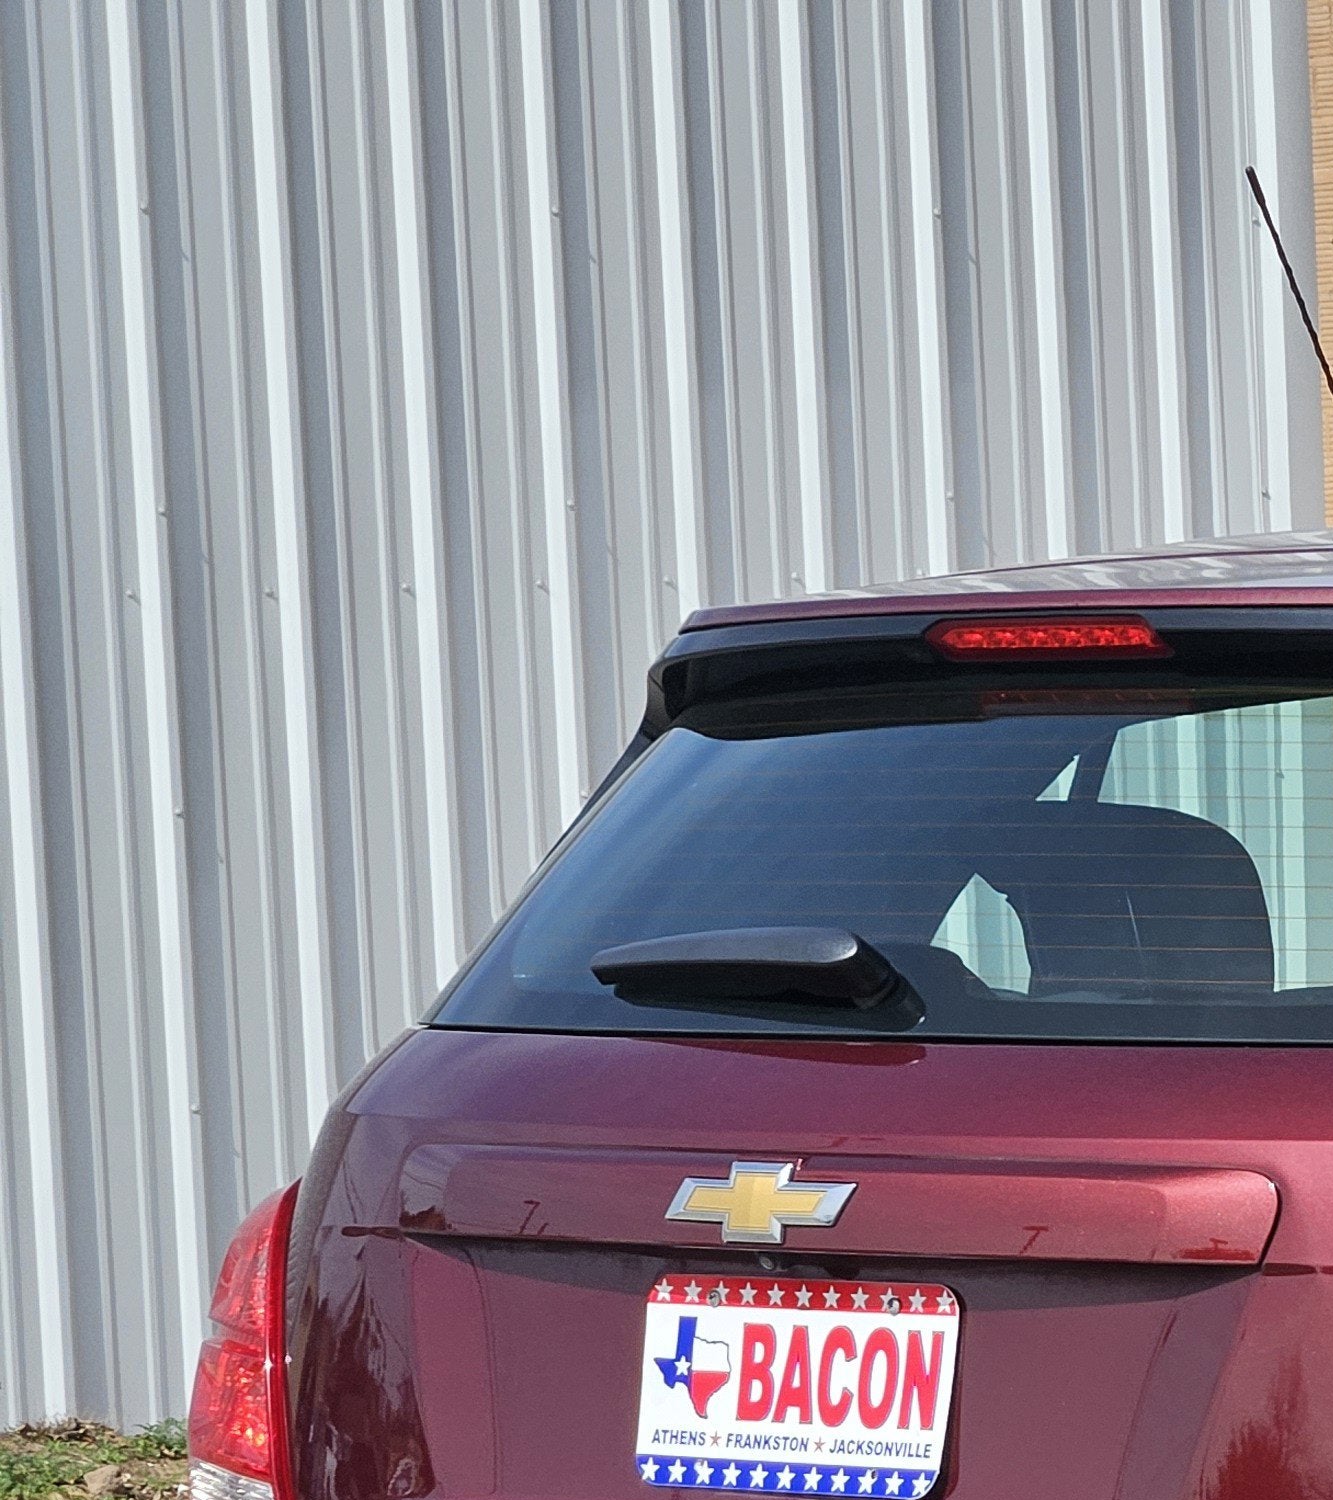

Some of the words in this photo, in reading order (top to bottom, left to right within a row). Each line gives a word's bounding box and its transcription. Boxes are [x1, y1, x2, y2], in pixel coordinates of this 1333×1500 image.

[736, 1322, 945, 1430] BACON
[651, 1429, 707, 1446] ATHENS
[725, 1433, 809, 1453] FRANKSTON
[829, 1439, 932, 1459] JACKSONVILLE
